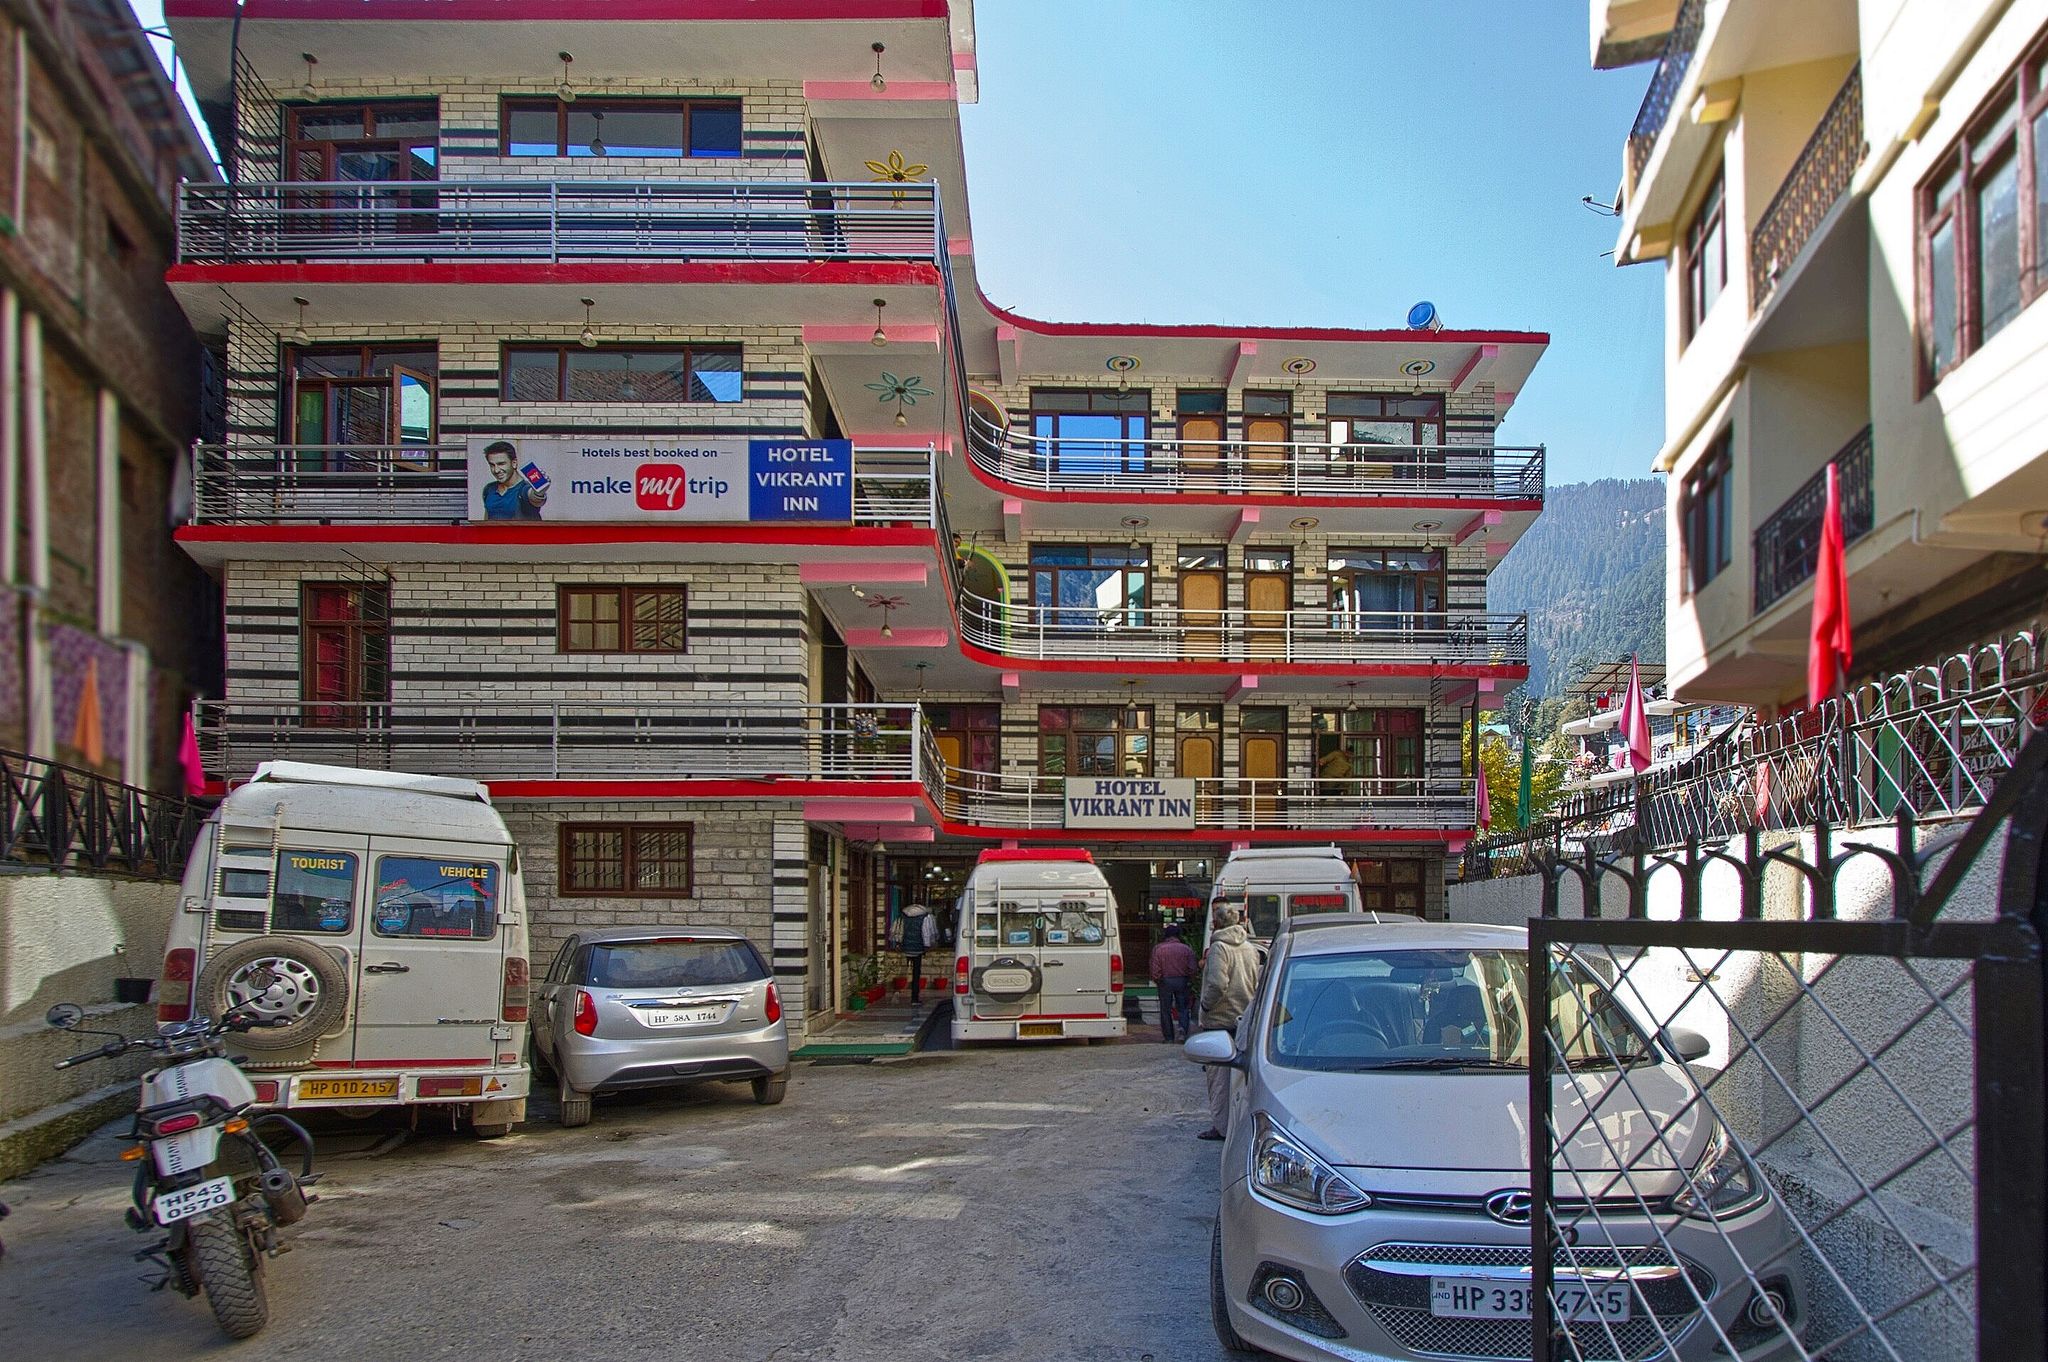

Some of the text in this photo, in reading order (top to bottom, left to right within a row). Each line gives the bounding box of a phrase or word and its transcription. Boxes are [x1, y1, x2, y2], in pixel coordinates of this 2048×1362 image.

[582, 448, 620, 458] Hotels
[624, 448, 650, 458] best
[653, 448, 699, 458] booked
[768, 448, 834, 462] HOTEL
[756, 472, 845, 487] VIKRANT
[571, 476, 728, 508] make my trip
[783, 497, 819, 511] INN
[1095, 780, 1166, 796] HOTEL
[1069, 798, 1191, 817] VIKRANT INN
[290, 857, 347, 871] TOURIST
[439, 866, 488, 879] VEHICLE
[654, 1015, 669, 1023] HP
[697, 1012, 717, 1021] 1744
[310, 1082, 328, 1095] HP
[361, 1082, 395, 1094] 2157
[165, 1183, 223, 1208] HP43
[167, 1194, 227, 1219] 0570
[1452, 1285, 1485, 1311] HP
